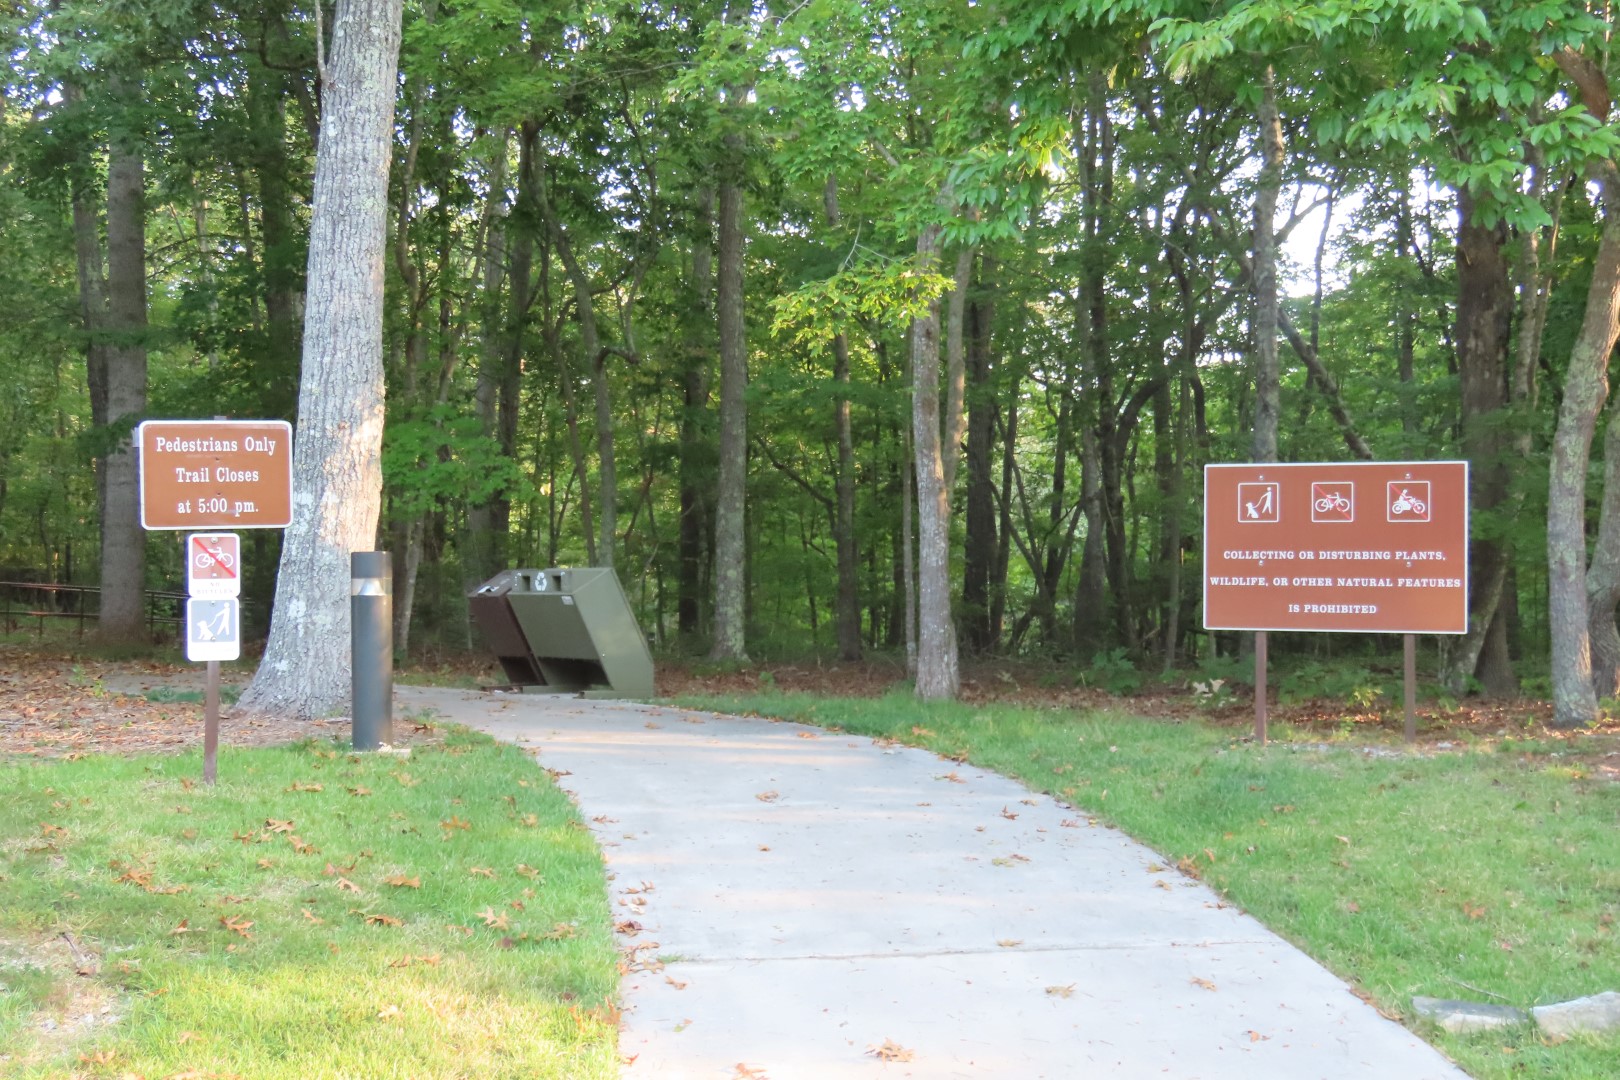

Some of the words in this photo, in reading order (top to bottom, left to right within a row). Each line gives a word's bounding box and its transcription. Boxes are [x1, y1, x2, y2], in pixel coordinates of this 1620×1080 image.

[156, 436, 238, 453] Pedestrians
[244, 436, 276, 456] Only
[175, 467, 210, 483] Trail
[216, 467, 259, 482] Closes
[177, 500, 191, 514] at
[198, 498, 228, 513] 5:00
[234, 501, 259, 517] pm.
[1223, 550, 1295, 560] COLLECTING
[1298, 550, 1315, 560] OR
[1318, 550, 1391, 560] DISTURBING
[1272, 577, 1289, 587] OR
[1292, 577, 1333, 587] OTHER
[1337, 578, 1393, 587] NATURAL
[1397, 578, 1461, 588] FEATURES
[1288, 604, 1300, 613] IS
[1303, 604, 1377, 614] PROHIBITED
